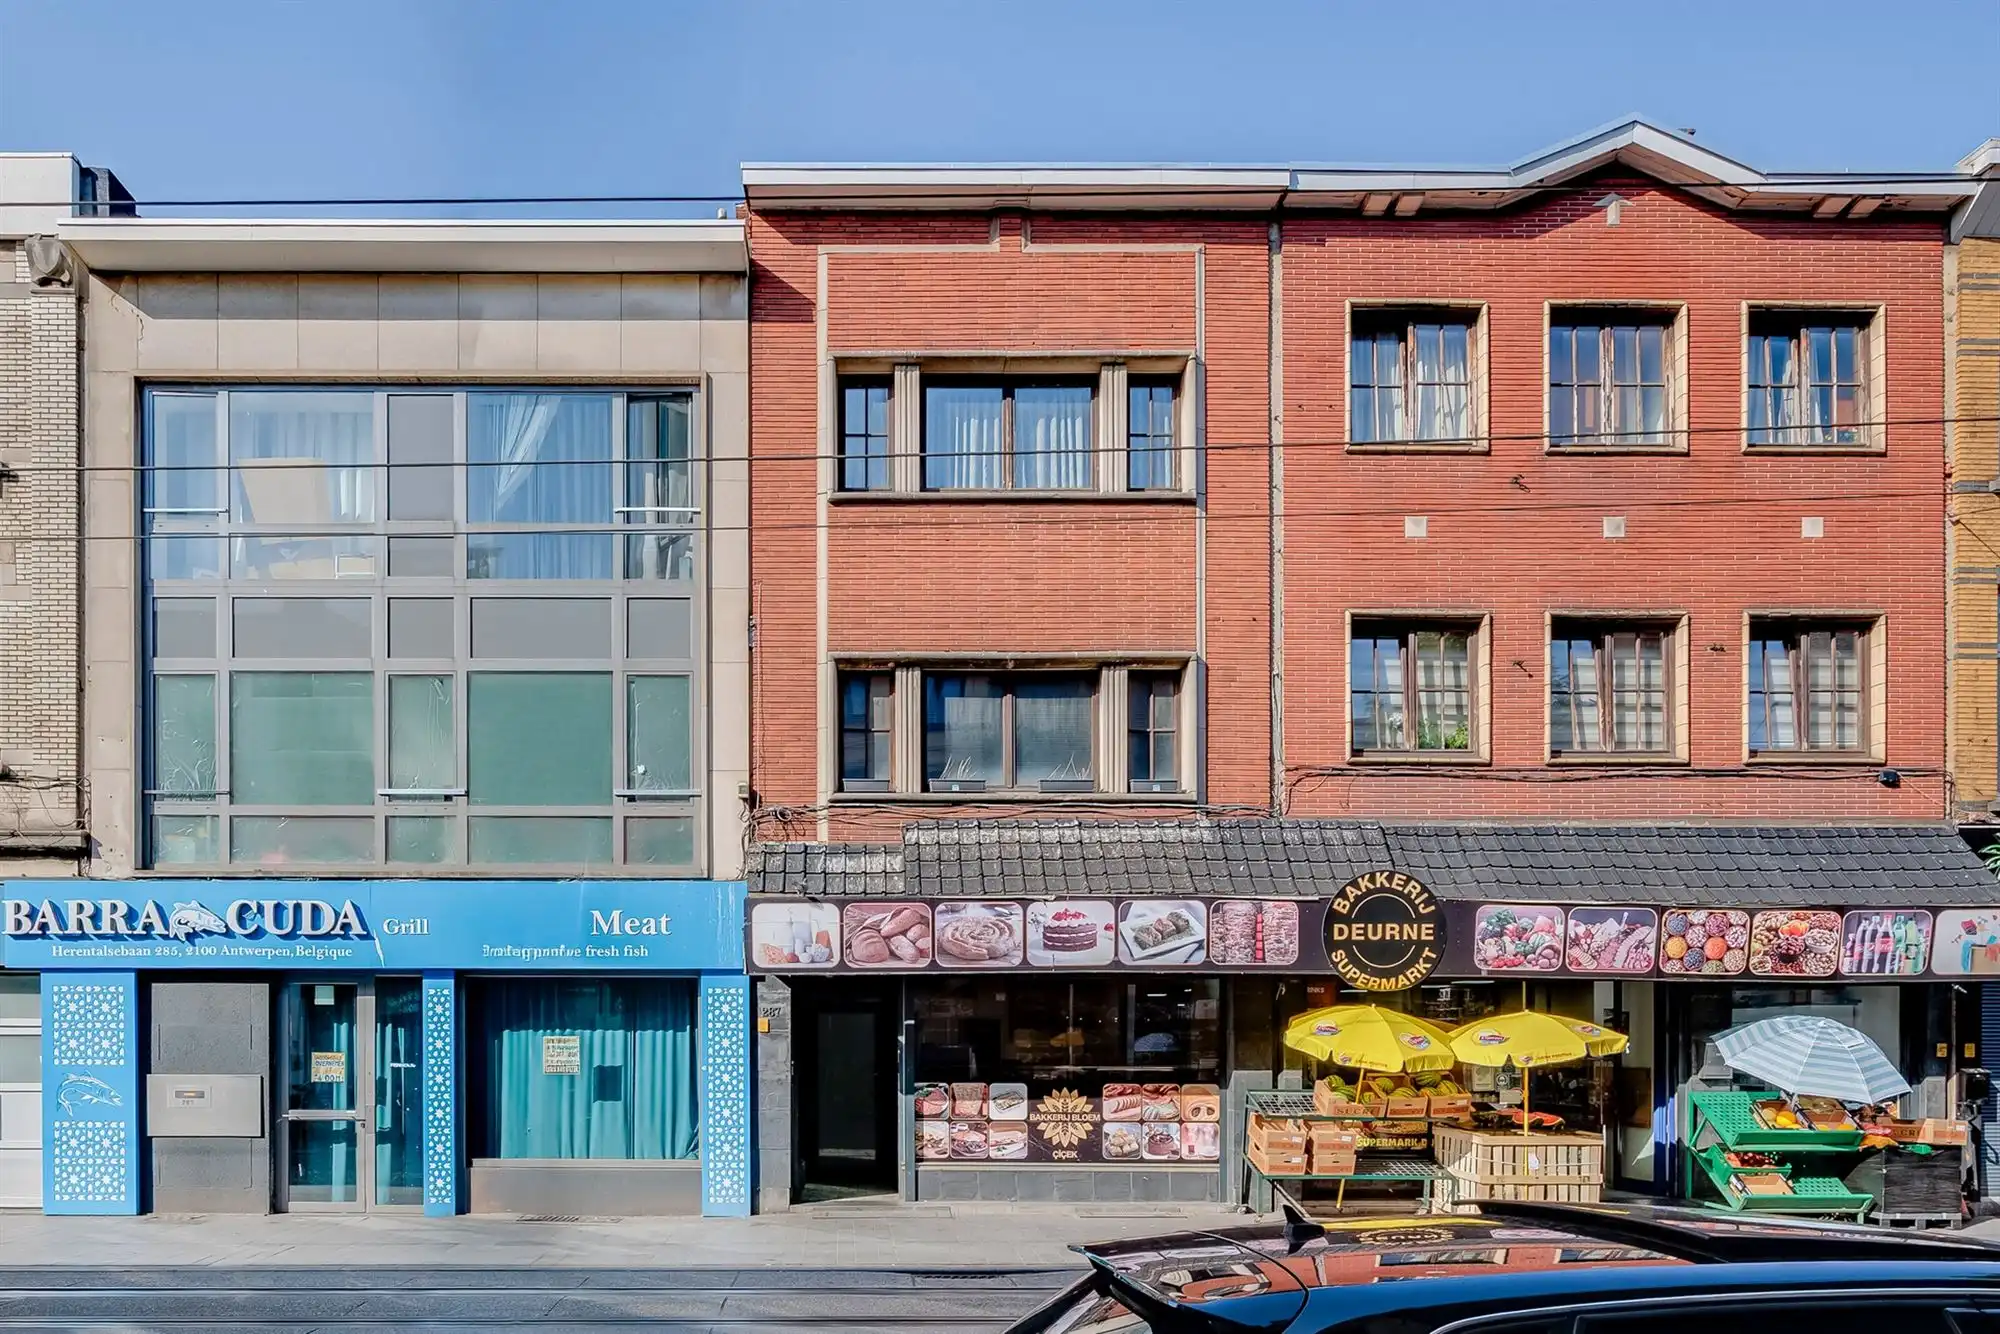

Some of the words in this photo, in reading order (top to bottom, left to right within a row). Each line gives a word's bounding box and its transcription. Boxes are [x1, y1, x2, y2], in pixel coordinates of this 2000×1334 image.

[1332, 871, 1436, 915] BAKKERIJ
[383, 918, 429, 936] Grill
[590, 909, 672, 936] Meat
[1333, 923, 1435, 941] DEURNE
[52, 944, 151, 957] Herentalsebaan
[155, 946, 182, 958] 285,
[186, 946, 217, 956] 2100
[585, 944, 620, 957] fresh
[623, 944, 649, 957] fish
[1331, 946, 1437, 991] SUPERMARKT
[1029, 1113, 1071, 1121] BAKKERIJ
[1071, 1113, 1101, 1121] BLOEM
